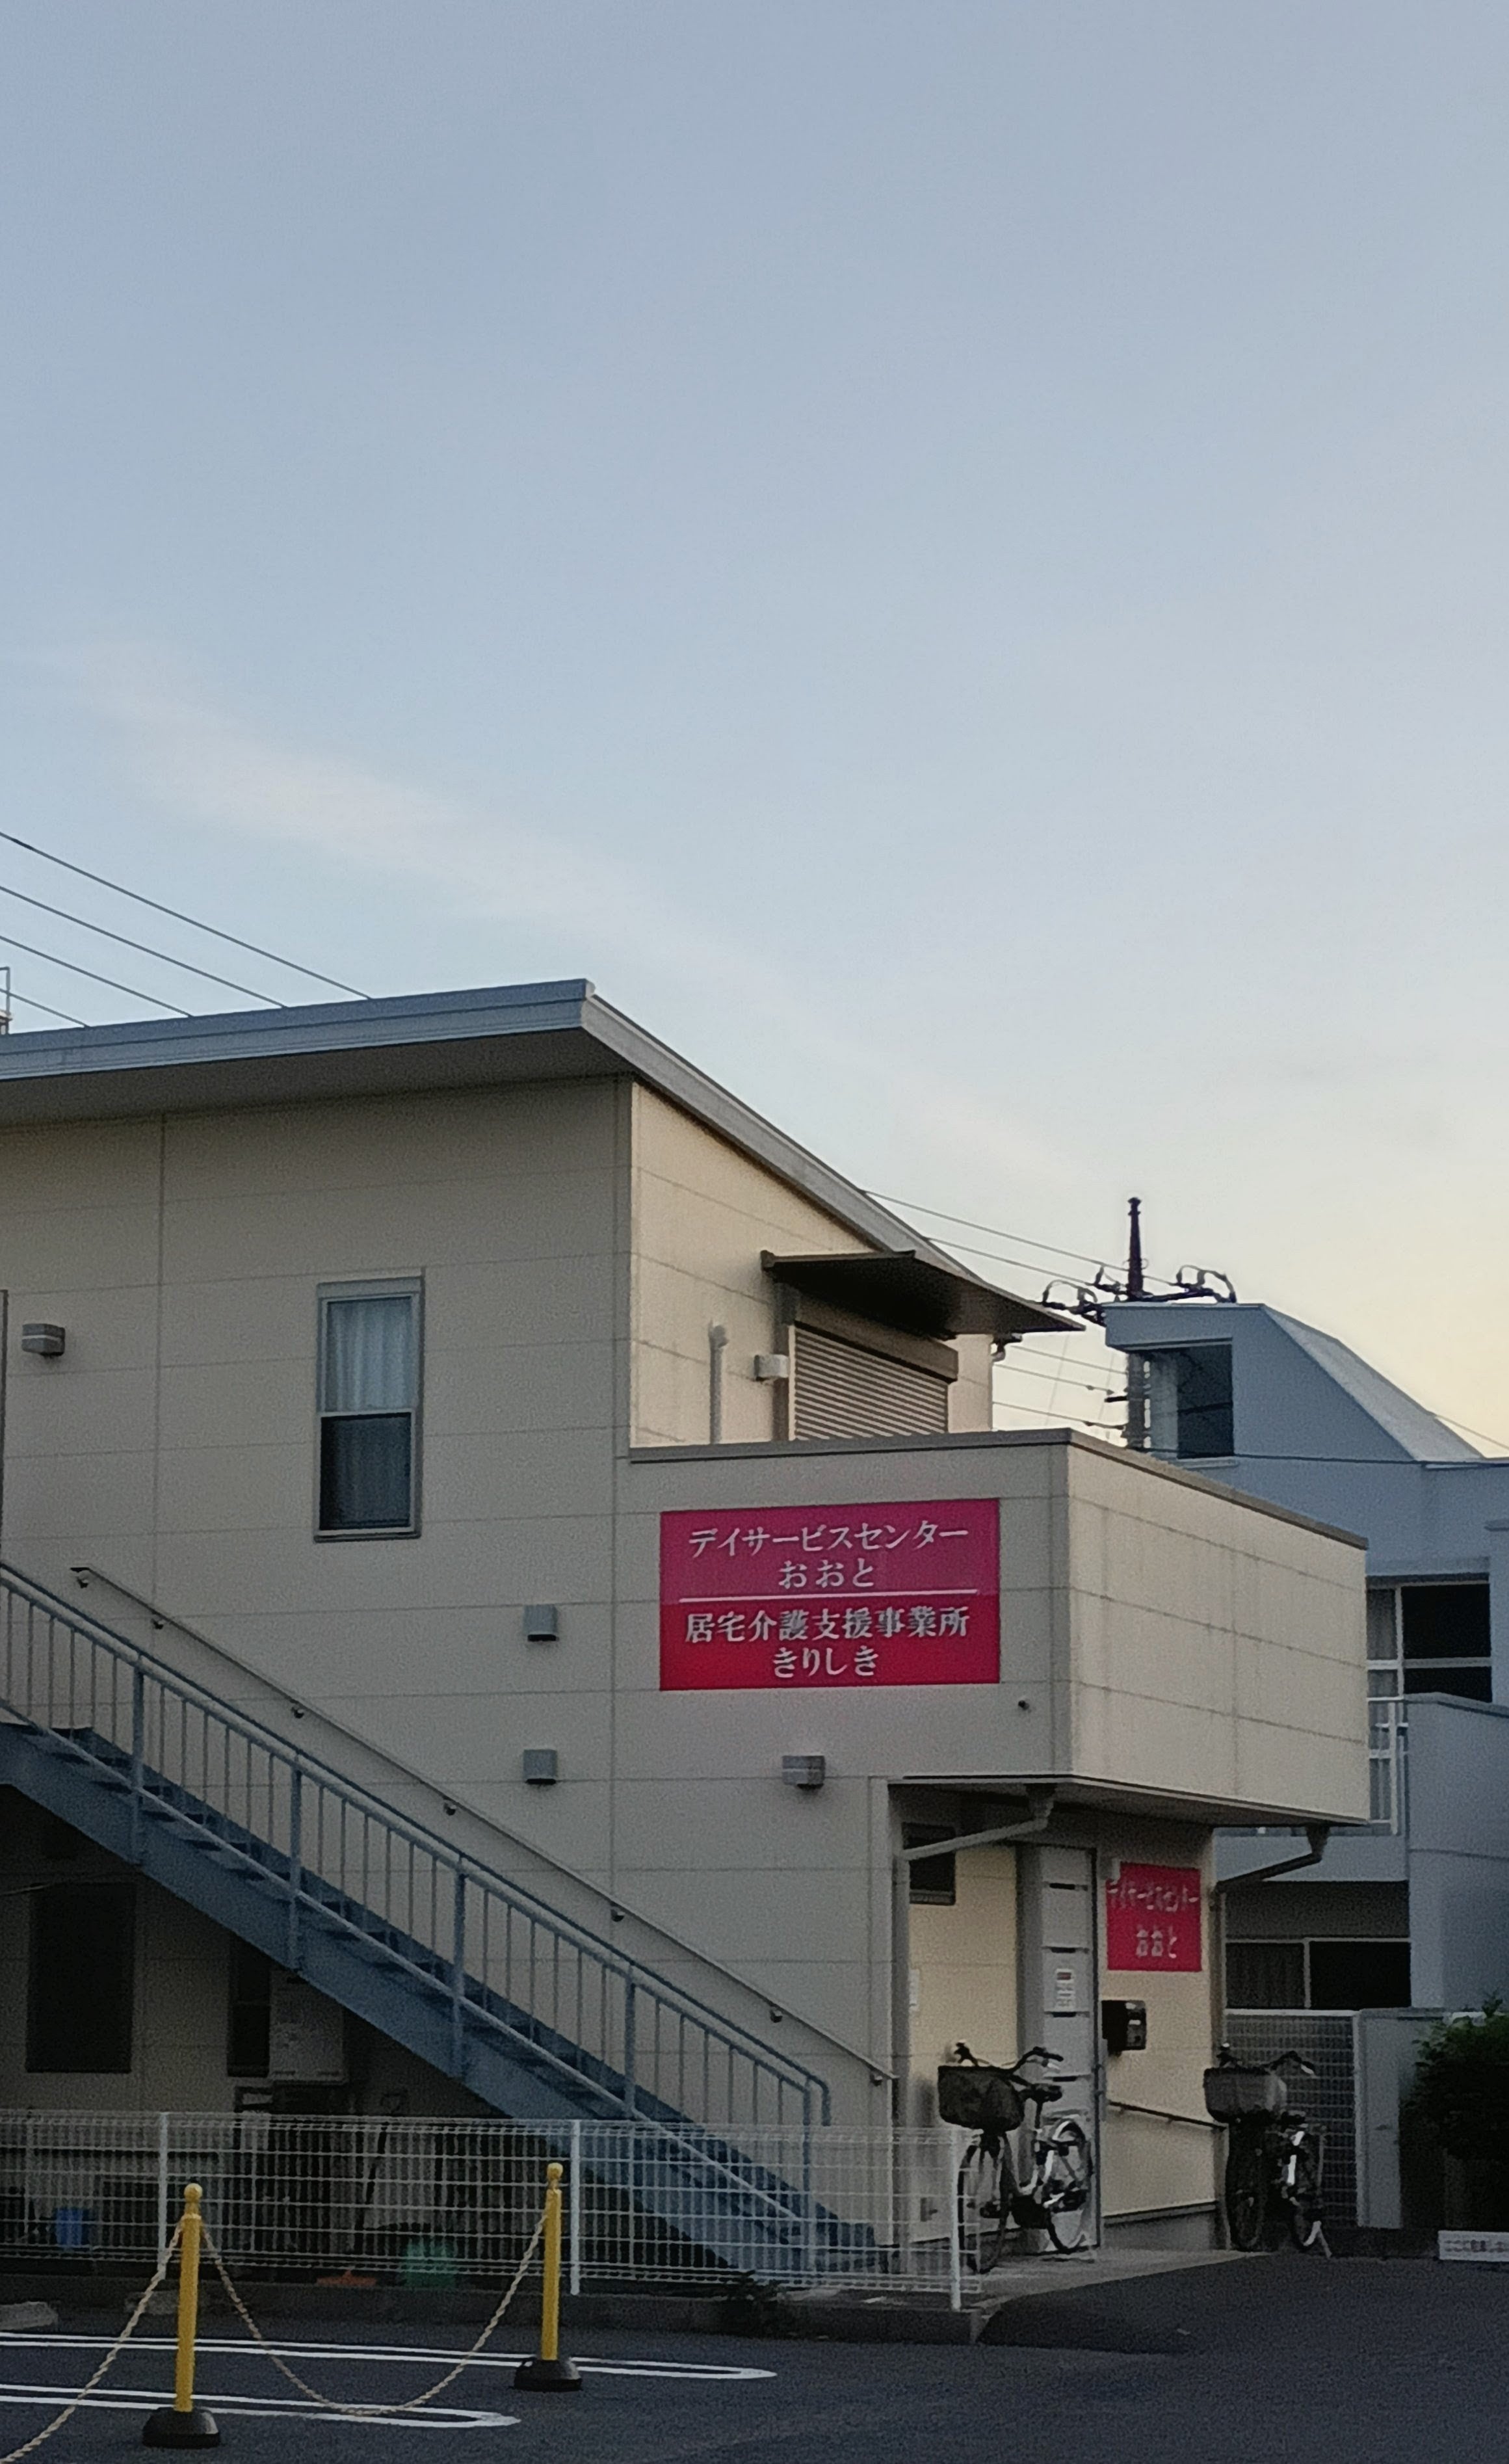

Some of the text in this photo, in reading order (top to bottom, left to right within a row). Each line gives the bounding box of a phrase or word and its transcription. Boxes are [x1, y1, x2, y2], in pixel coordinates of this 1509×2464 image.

[689, 1520, 969, 1558] デイサービスセンター
[778, 1558, 874, 1589] おおと
[685, 1606, 969, 1643] 居宅介護支援事業所
[773, 1645, 879, 1678] きりしき
